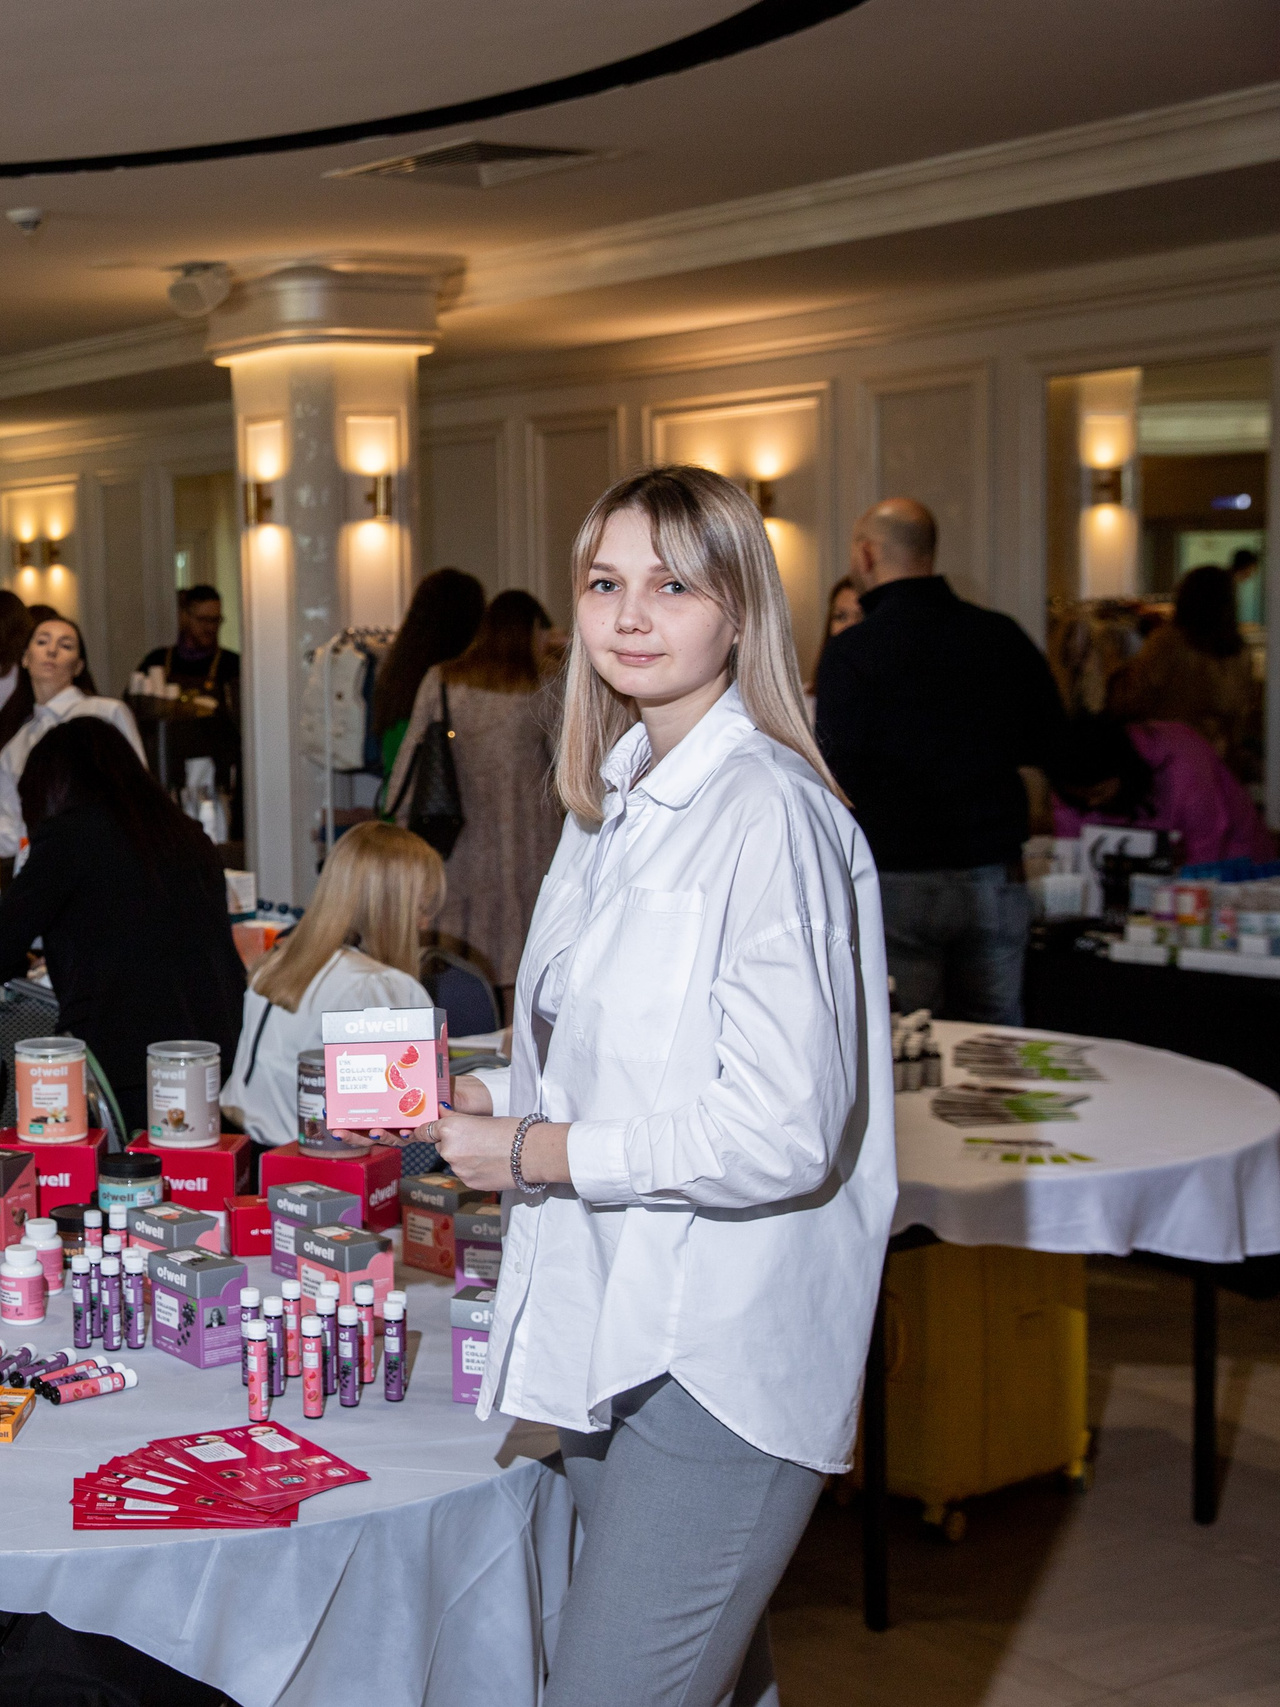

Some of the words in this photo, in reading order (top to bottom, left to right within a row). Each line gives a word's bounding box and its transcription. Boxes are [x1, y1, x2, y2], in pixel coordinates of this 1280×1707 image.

[344, 1017, 408, 1034] o!well
[30, 1065, 68, 1077] o!well
[36, 1173, 71, 1187] well
[102, 1191, 134, 1202] o!well
[370, 1179, 398, 1206] o!well
[410, 1189, 445, 1207] o!well
[277, 1198, 308, 1217] o!well
[135, 1220, 164, 1240] o!well
[471, 1223, 500, 1236] o!w
[303, 1241, 335, 1262] o!well
[156, 1266, 187, 1287] o!well
[241, 1312, 251, 1321] o!
[339, 1332, 349, 1340] o!
[386, 1327, 397, 1336] o!
[305, 1342, 315, 1351] o!
